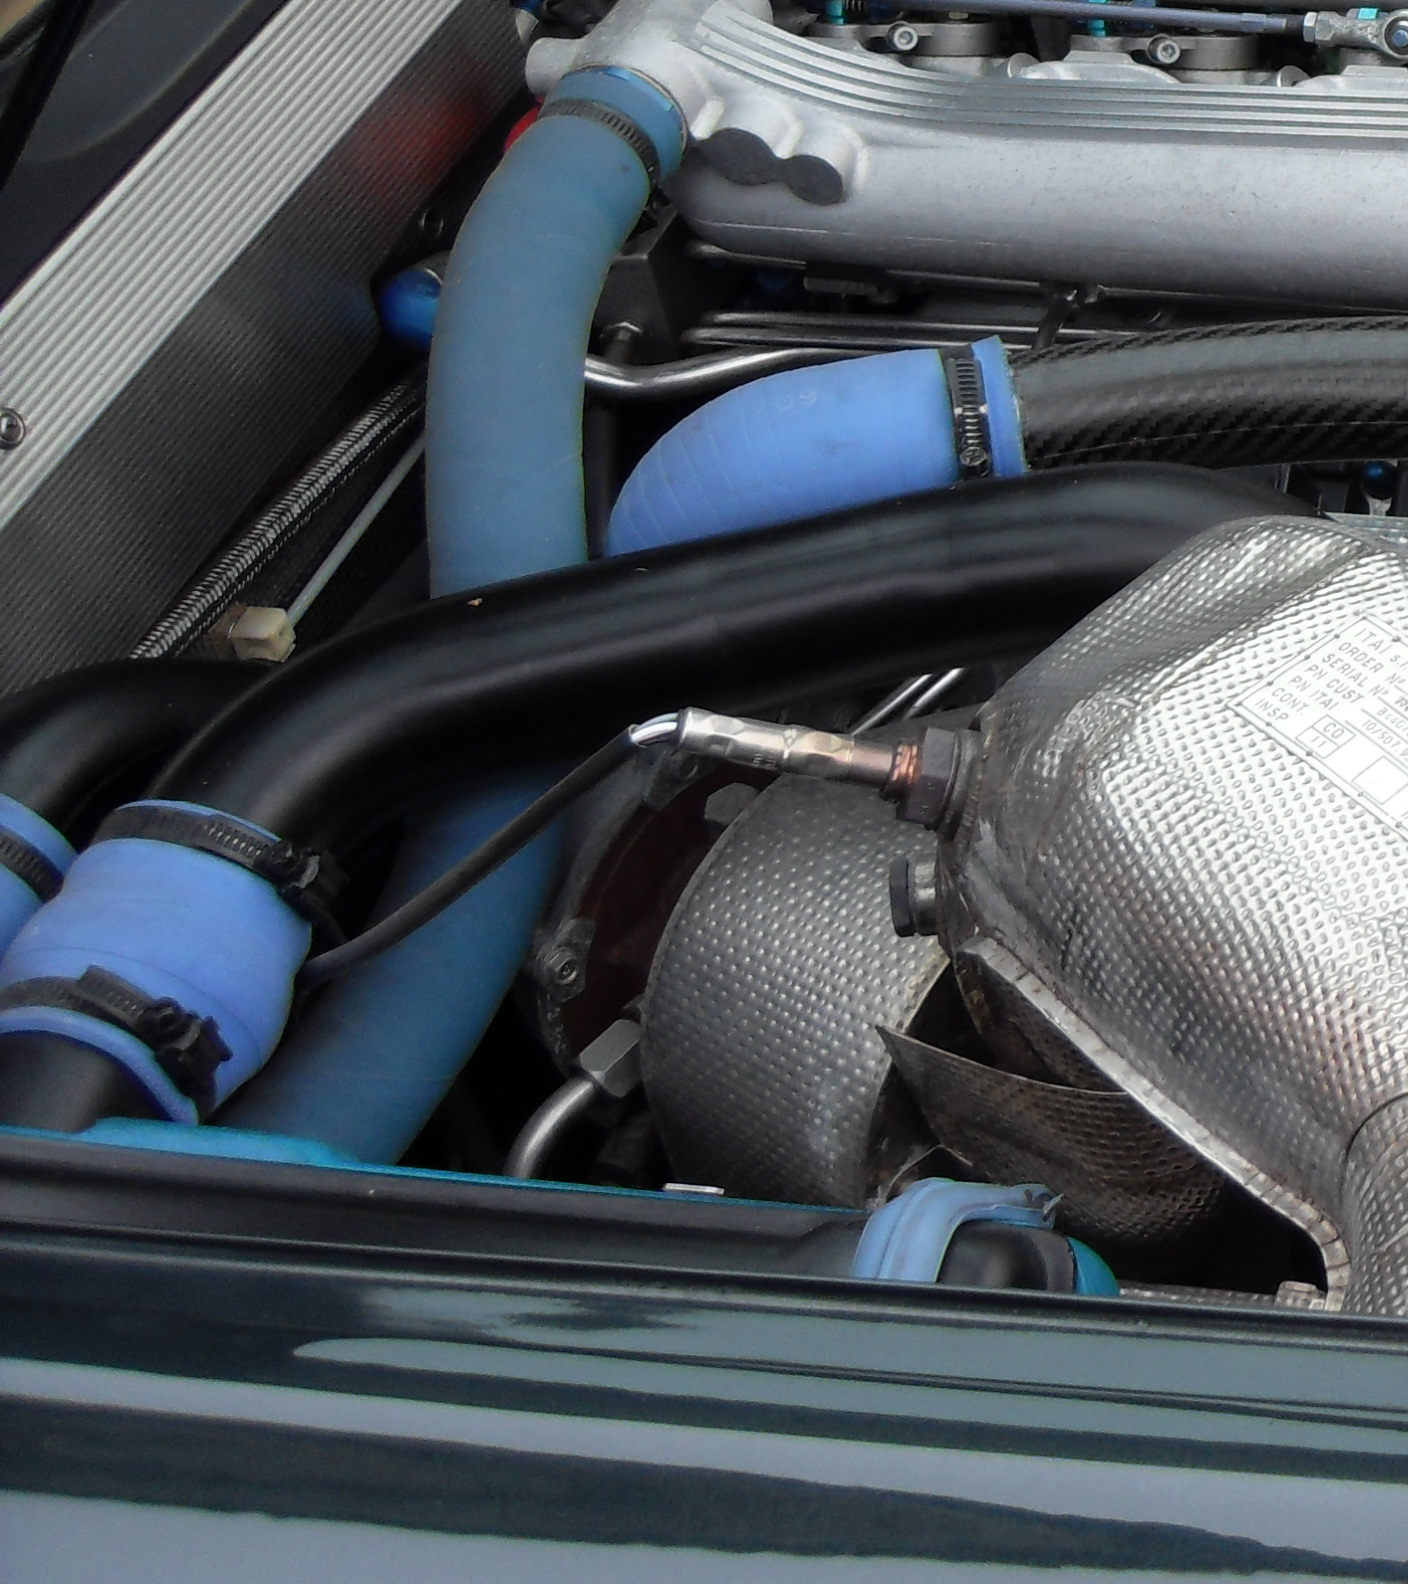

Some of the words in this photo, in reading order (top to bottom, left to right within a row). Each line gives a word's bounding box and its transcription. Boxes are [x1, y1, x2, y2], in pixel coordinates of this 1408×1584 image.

[1322, 653, 1368, 687] SERIAL
[1338, 642, 1384, 674] ORDER
[1288, 675, 1311, 692] PN
[1304, 664, 1328, 680] PN
[1326, 680, 1365, 703] CUST
[1254, 699, 1289, 720] INSP
[1271, 688, 1309, 716] CONT.
